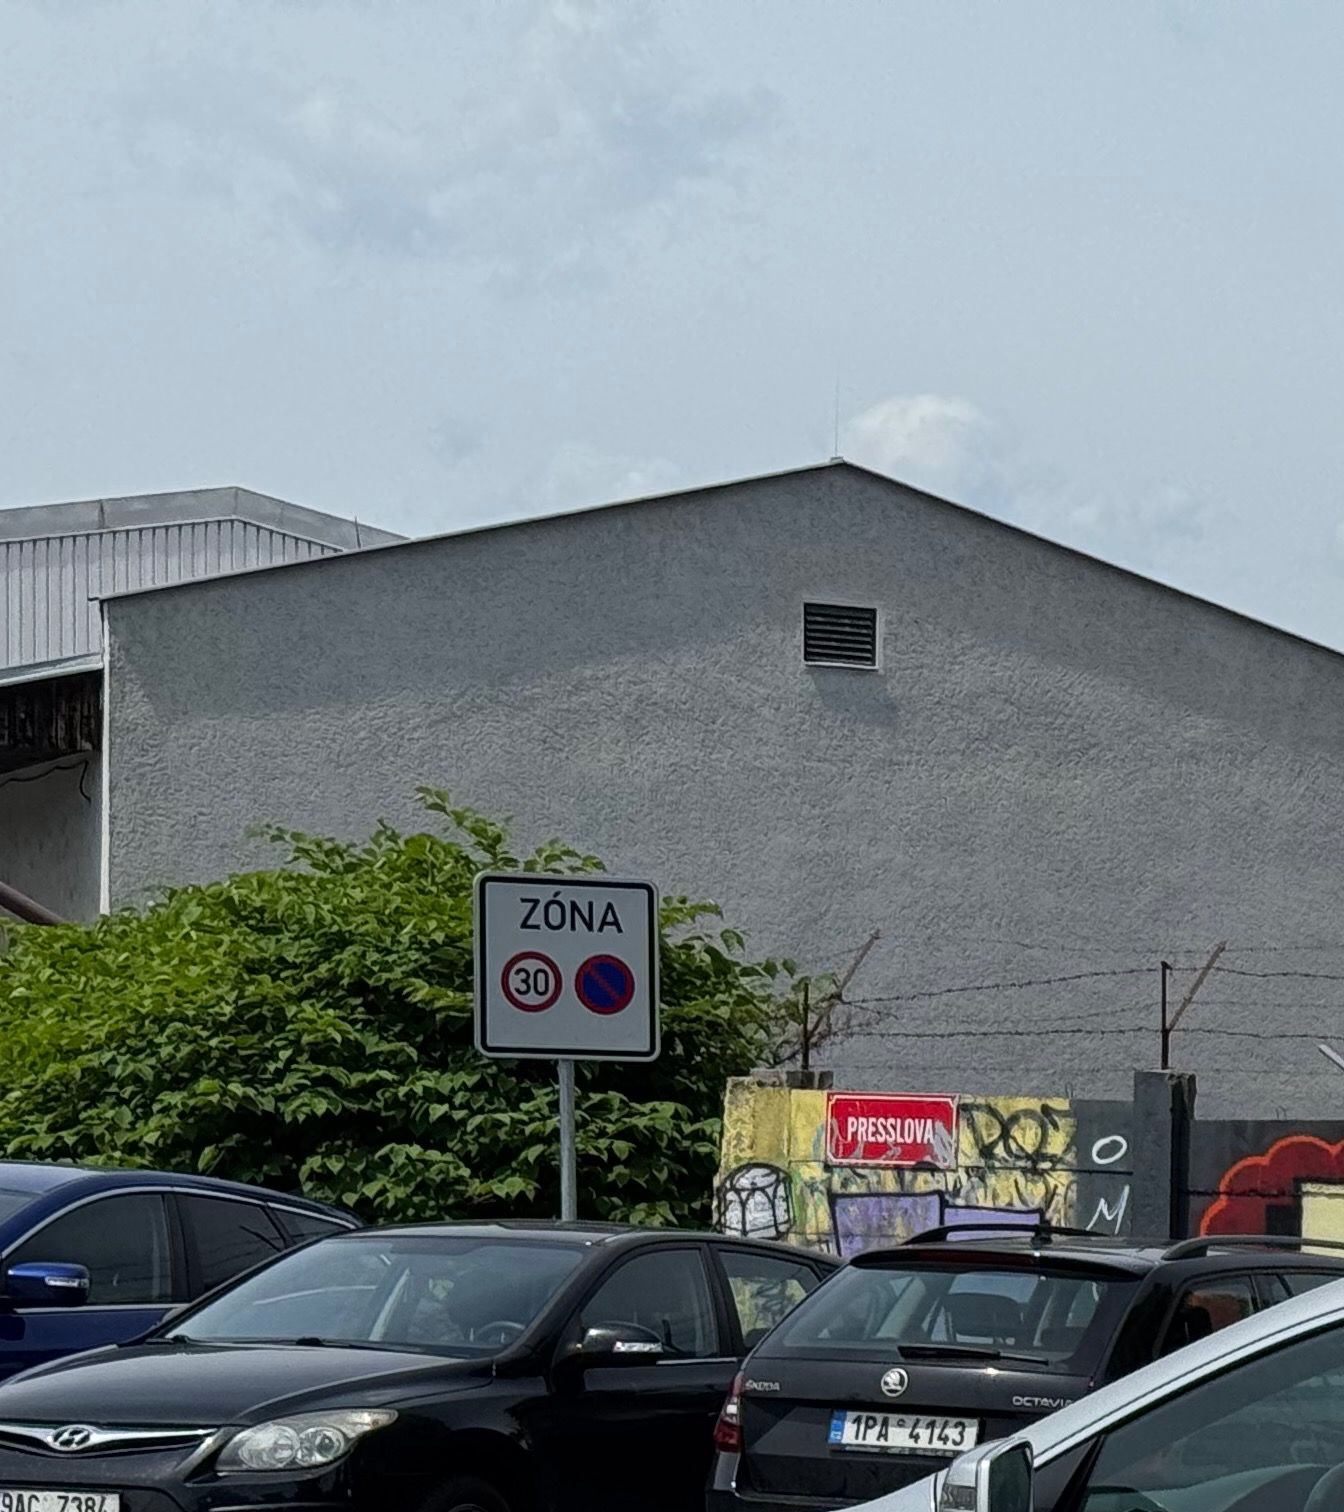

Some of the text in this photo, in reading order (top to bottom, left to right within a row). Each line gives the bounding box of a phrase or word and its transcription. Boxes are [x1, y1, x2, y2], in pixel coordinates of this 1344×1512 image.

[519, 890, 624, 934] ZÓNA
[513, 967, 550, 997] 30
[847, 1116, 934, 1145] PRESSLOVA
[851, 1413, 966, 1446] 1PA 4143
